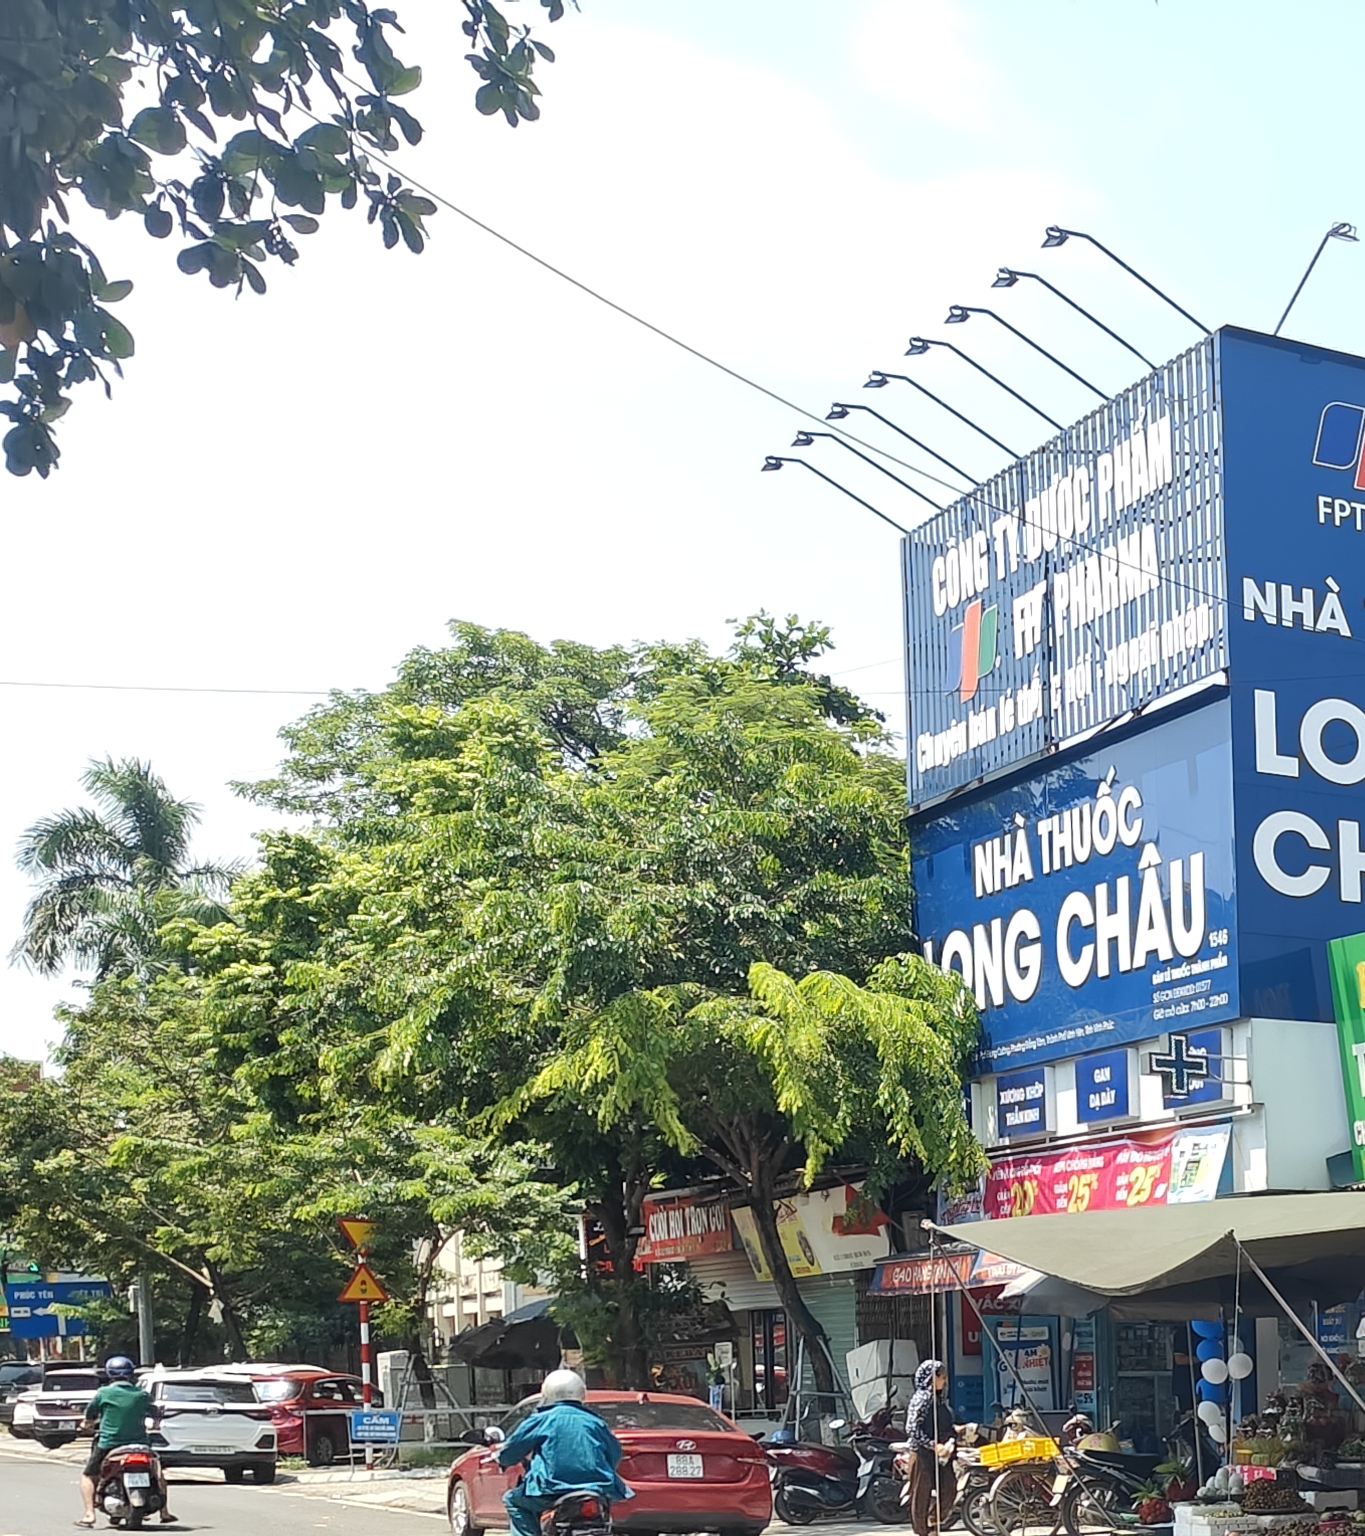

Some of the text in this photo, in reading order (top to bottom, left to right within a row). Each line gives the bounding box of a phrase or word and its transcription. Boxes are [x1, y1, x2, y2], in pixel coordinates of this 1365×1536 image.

[1318, 495, 1365, 531] FPT
[932, 537, 989, 616] CÔNG
[1053, 523, 1160, 639] PHARMA
[1243, 576, 1352, 637] NHÀ
[974, 765, 1143, 898] NHÀ THUỐC
[923, 842, 1205, 1012] ONG CHÂU
[1094, 1067, 1111, 1083] GAN
